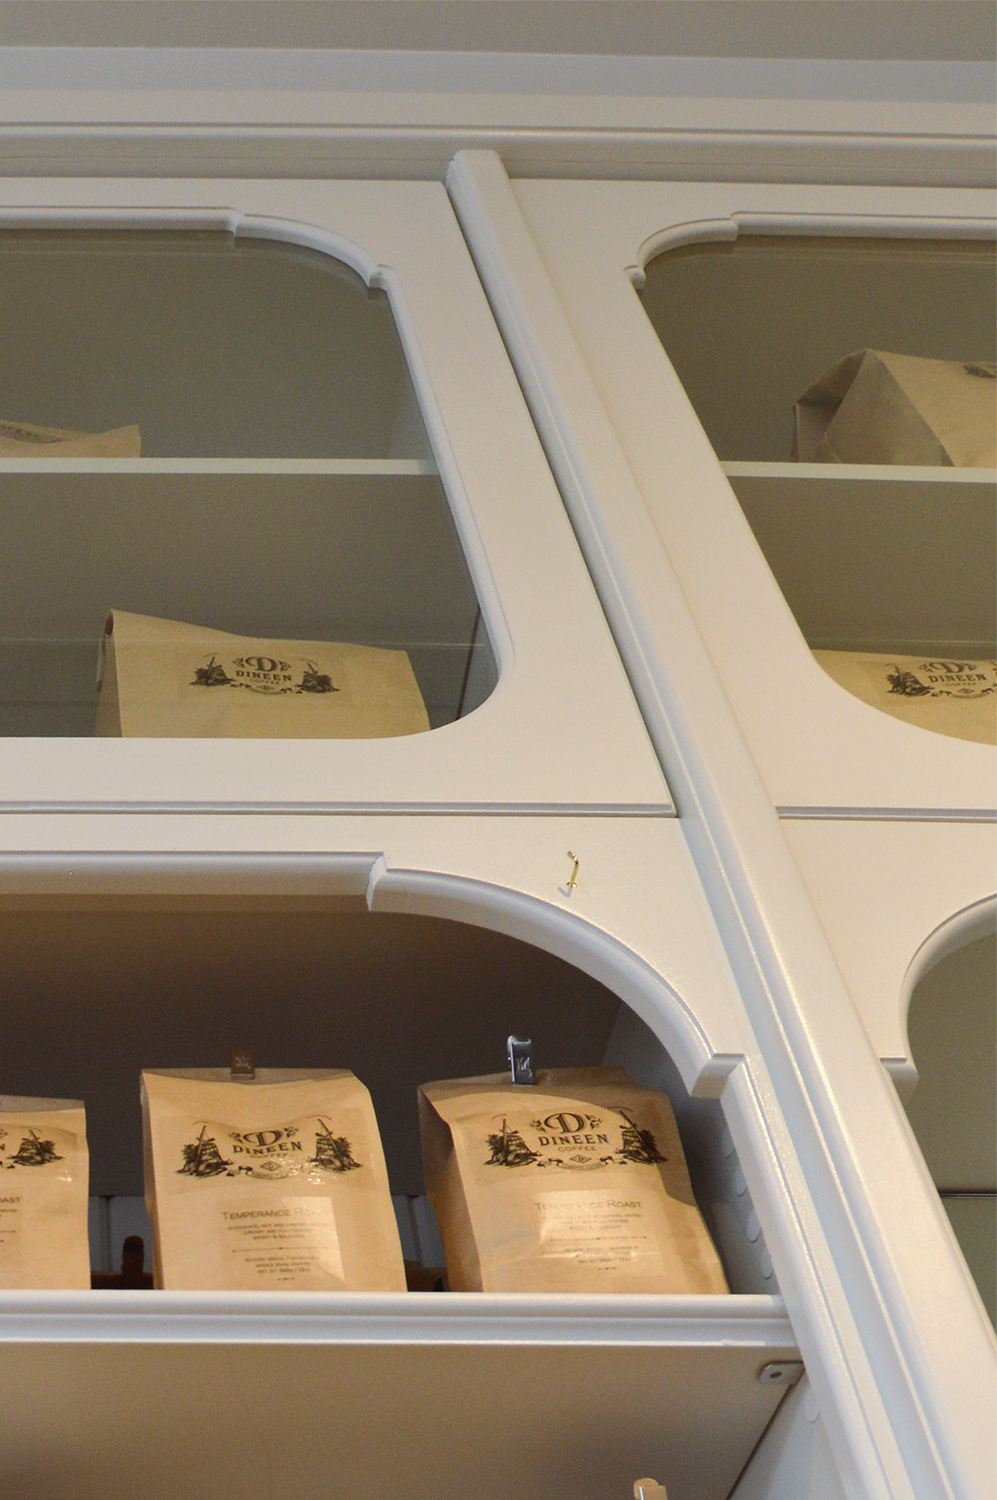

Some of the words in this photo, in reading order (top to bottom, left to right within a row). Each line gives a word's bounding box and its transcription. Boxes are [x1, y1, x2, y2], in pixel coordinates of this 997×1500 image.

[236, 670, 292, 681] DINEEN
[928, 673, 987, 683] DINEEN
[543, 1112, 585, 1134] D
[538, 1134, 610, 1147] DINEEN
[233, 1141, 302, 1155] DINEEN
[607, 1199, 642, 1208] ROAST
[222, 1209, 291, 1220] TEMPERANCE
